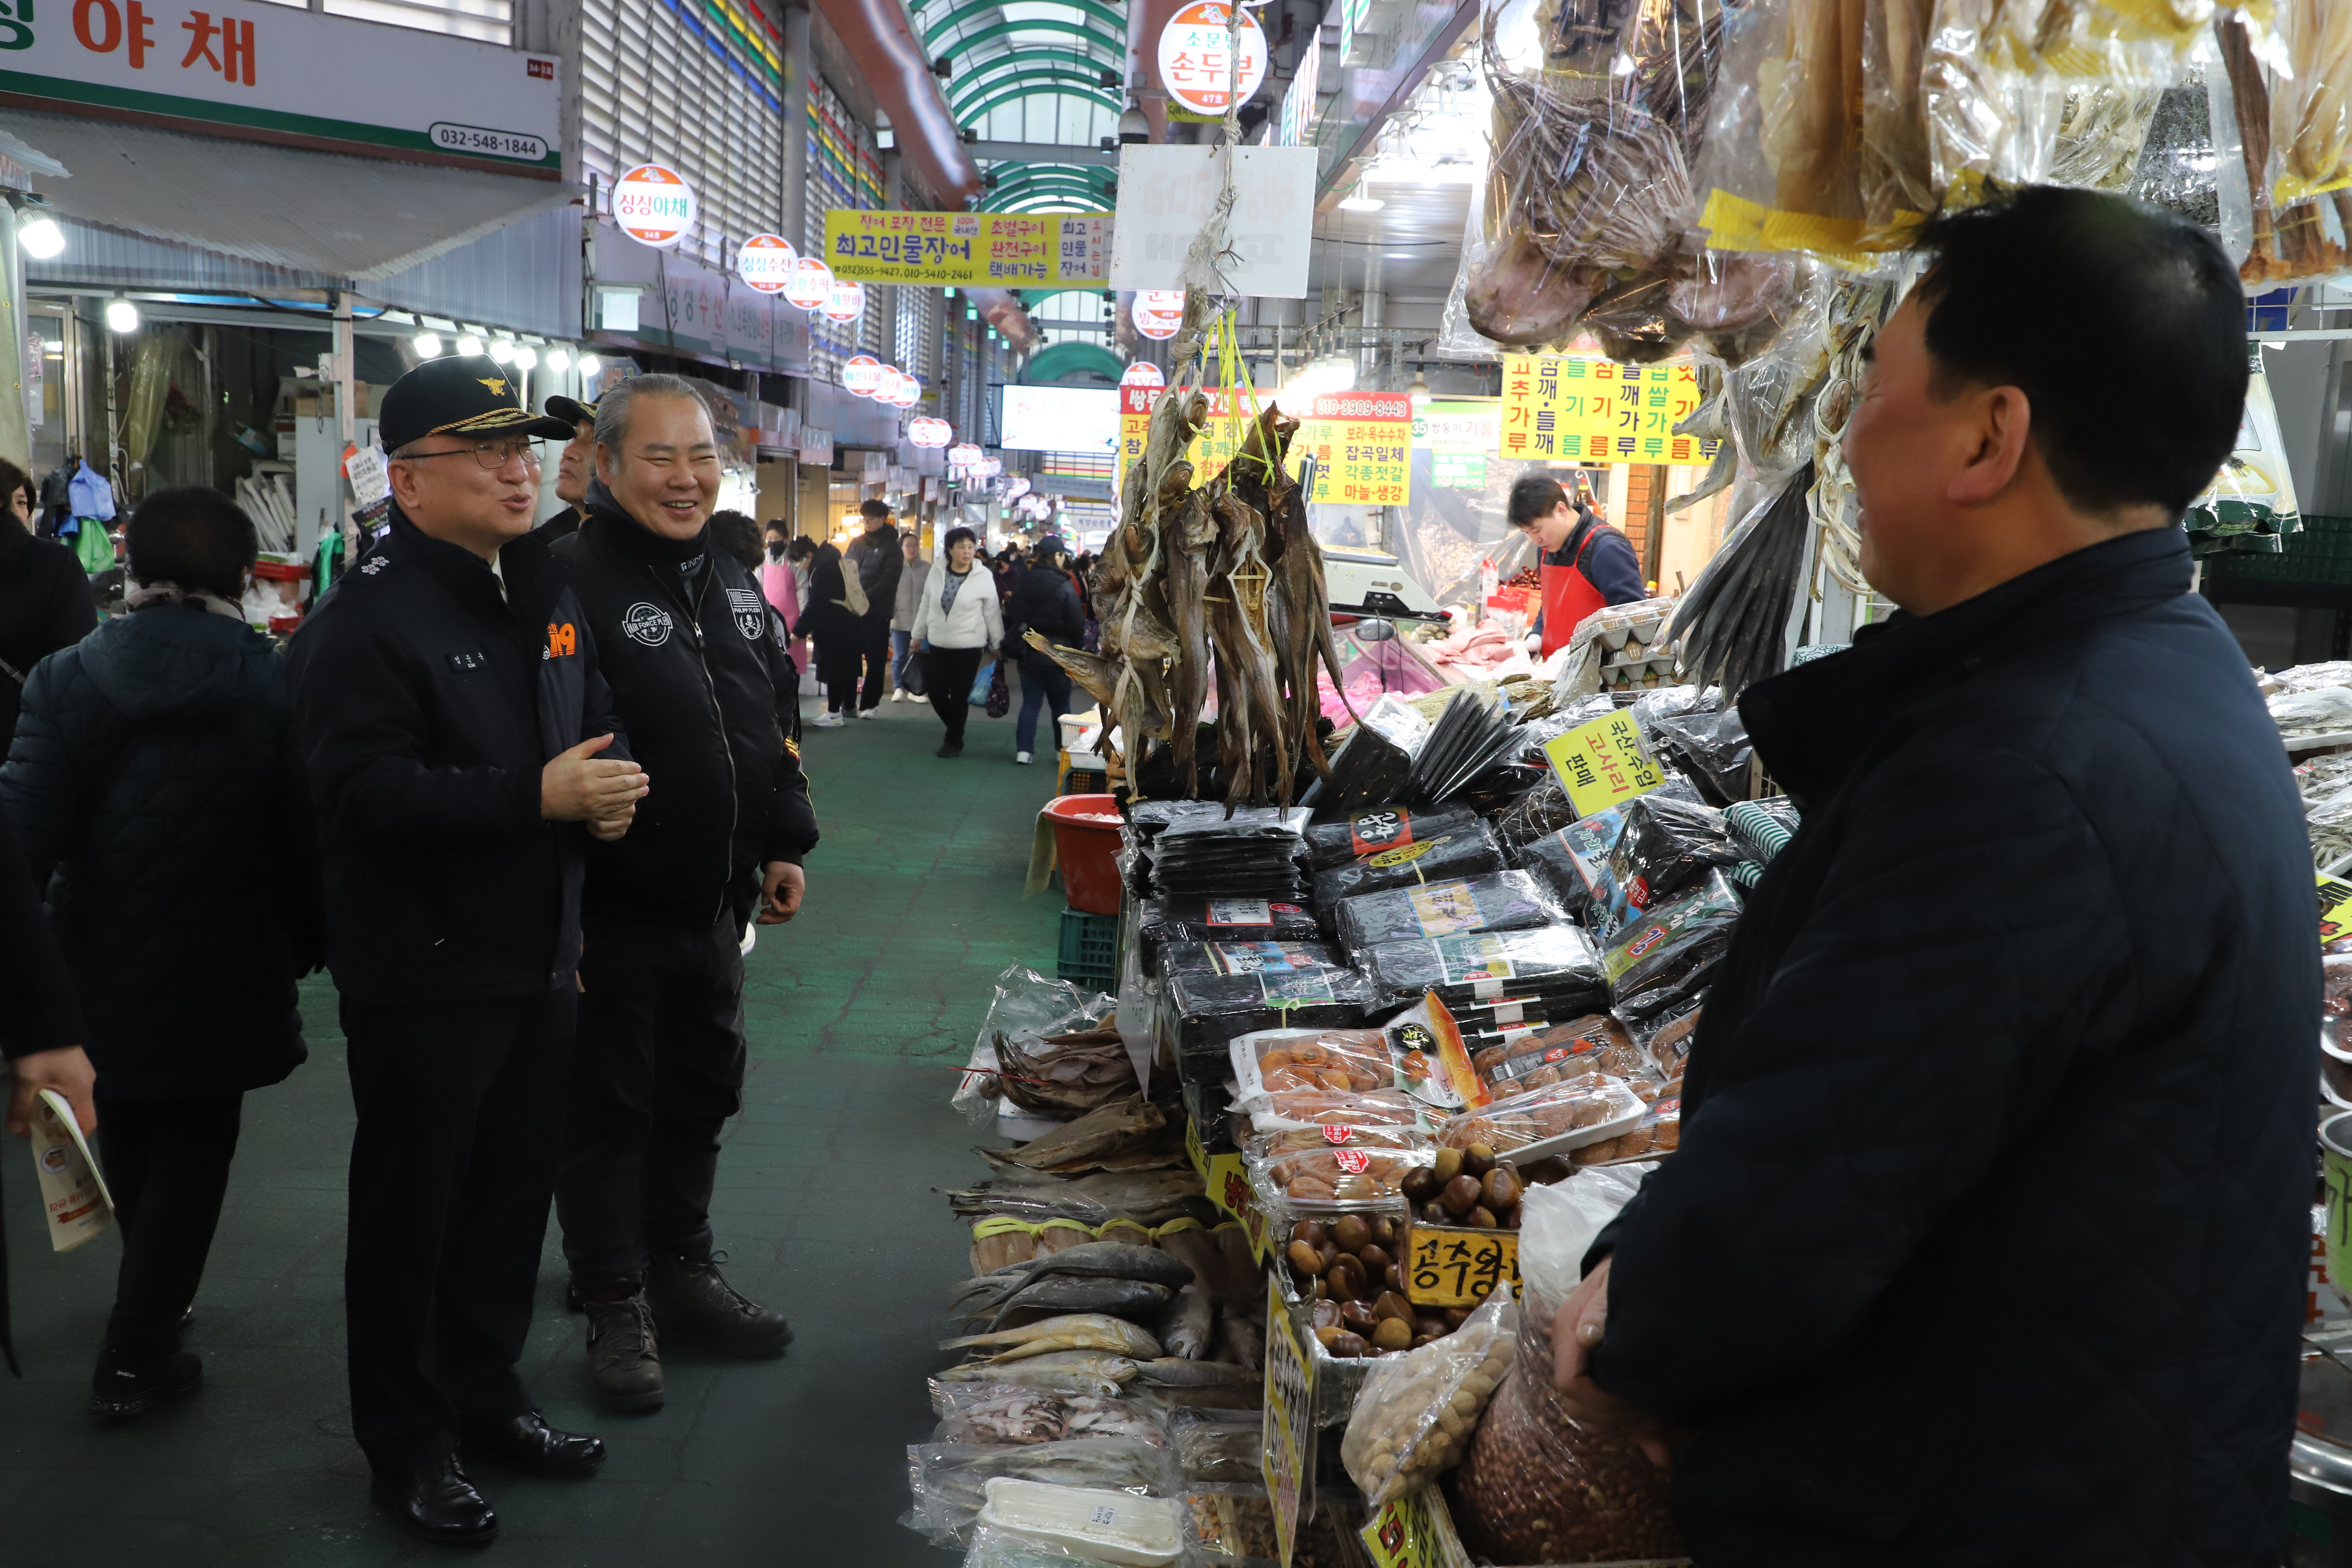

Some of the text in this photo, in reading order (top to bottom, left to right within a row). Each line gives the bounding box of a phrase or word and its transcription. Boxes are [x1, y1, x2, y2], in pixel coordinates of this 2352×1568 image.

[1170, 51, 1253, 84] 손두부
[1202, 94, 1223, 104] 47호
[441, 129, 537, 155] 032-548-1844
[619, 194, 687, 217] 싱싱야채
[861, 215, 945, 232] 장어 포장 전문
[957, 217, 975, 225] 100%
[991, 220, 1044, 237] 초벌구이
[1063, 222, 1087, 235] 최고
[954, 226, 978, 235] 국내산
[836, 233, 970, 264] 최고민물장어
[991, 241, 1046, 258] 완전구이
[1062, 241, 1087, 257] 민물
[743, 257, 791, 273] 싱싱수산
[990, 261, 1047, 279] 택배가능
[1061, 261, 1086, 277] 장어
[825, 294, 861, 307] 제핫바
[1317, 399, 1407, 416] 010-3909-8443
[1412, 420, 1427, 435] 35
[1431, 423, 1461, 434] 쌍둥이
[1346, 446, 1404, 462] 잡곡일체
[1345, 465, 1404, 482] 각종젓갈
[1344, 484, 1403, 501] 마늘·생강
[639, 619, 657, 629] FORCE
[1565, 753, 1597, 787] 판매
[1585, 733, 1631, 793] 고사리
[1628, 879, 1648, 904] 곱창김
